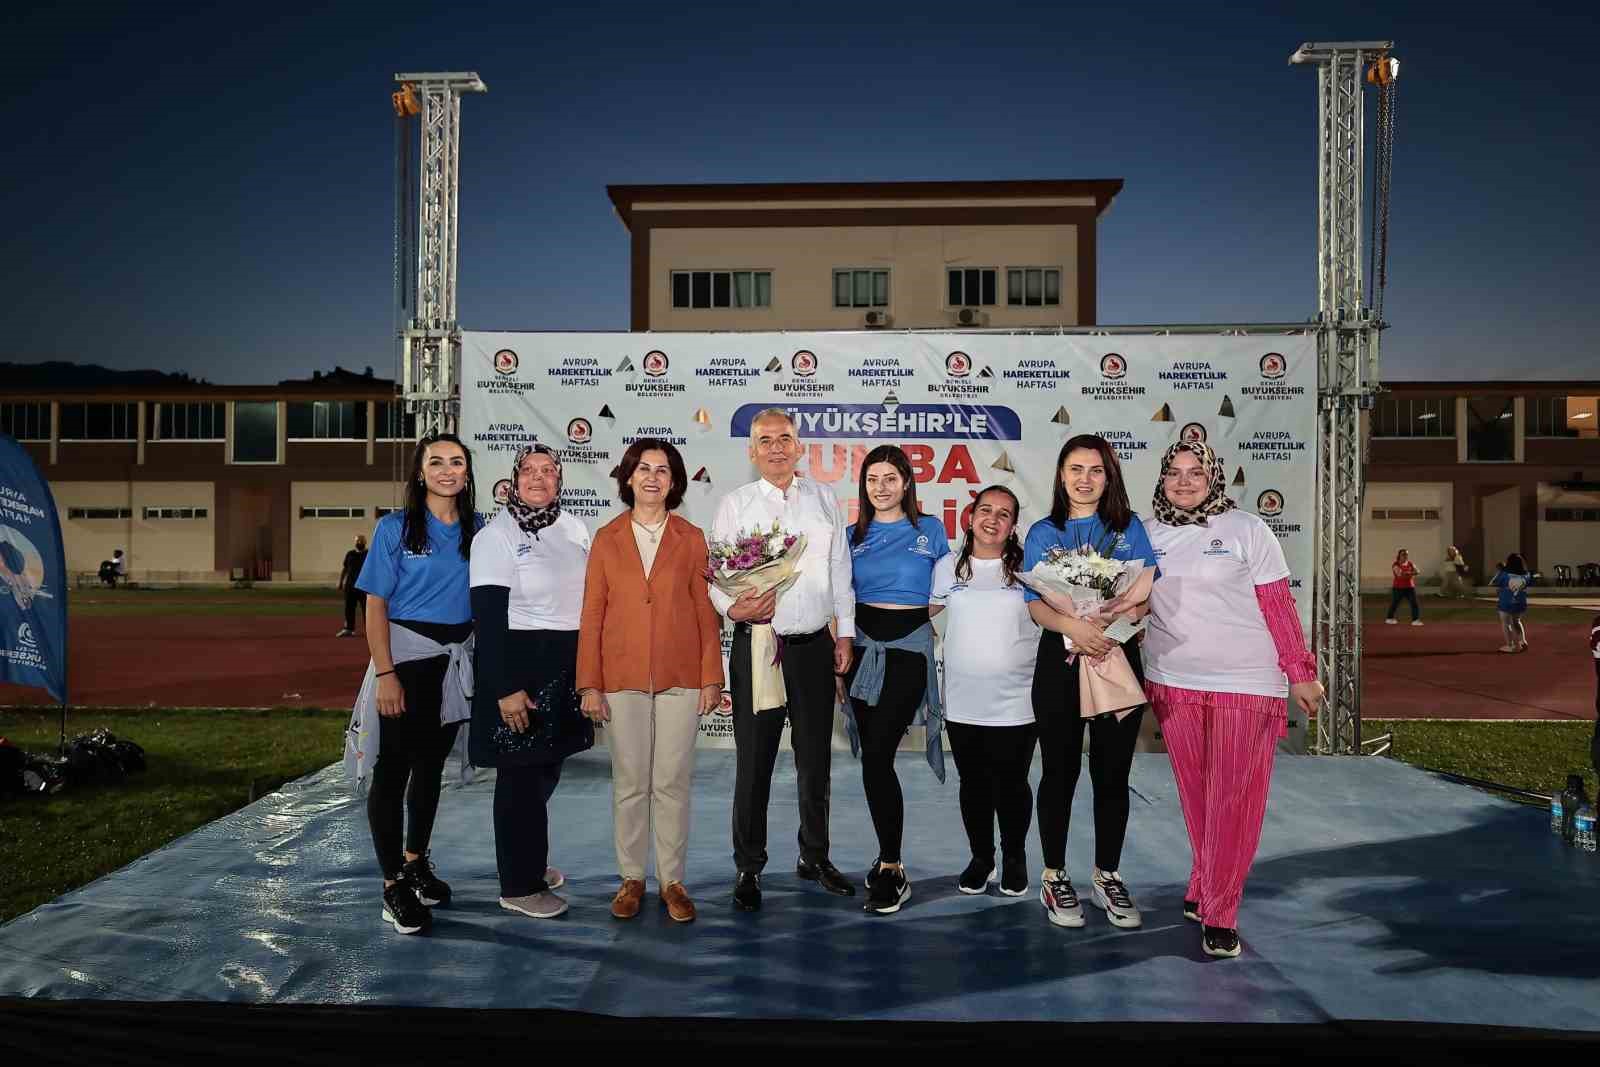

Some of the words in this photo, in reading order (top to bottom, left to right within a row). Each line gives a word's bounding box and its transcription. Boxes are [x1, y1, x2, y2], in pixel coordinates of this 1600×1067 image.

[562, 358, 599, 367] AVRUPA
[710, 358, 746, 367] AVRUPA
[862, 358, 900, 367] AVRUPA
[1017, 359, 1056, 369] AVRUPA
[1172, 361, 1212, 371] AVRUPA
[561, 378, 600, 387] HAFTASI
[708, 378, 747, 387] HAFTASI
[861, 379, 901, 388] HAFTASI
[1016, 380, 1057, 390] HAFTASI
[1173, 381, 1214, 391] HAFTASI
[488, 423, 525, 432] AVRUPA
[636, 426, 674, 436] AVRUPA
[1253, 431, 1292, 440] AVRUPA
[1252, 452, 1292, 462] HAFTASI
[561, 488, 597, 497] AVRUPA
